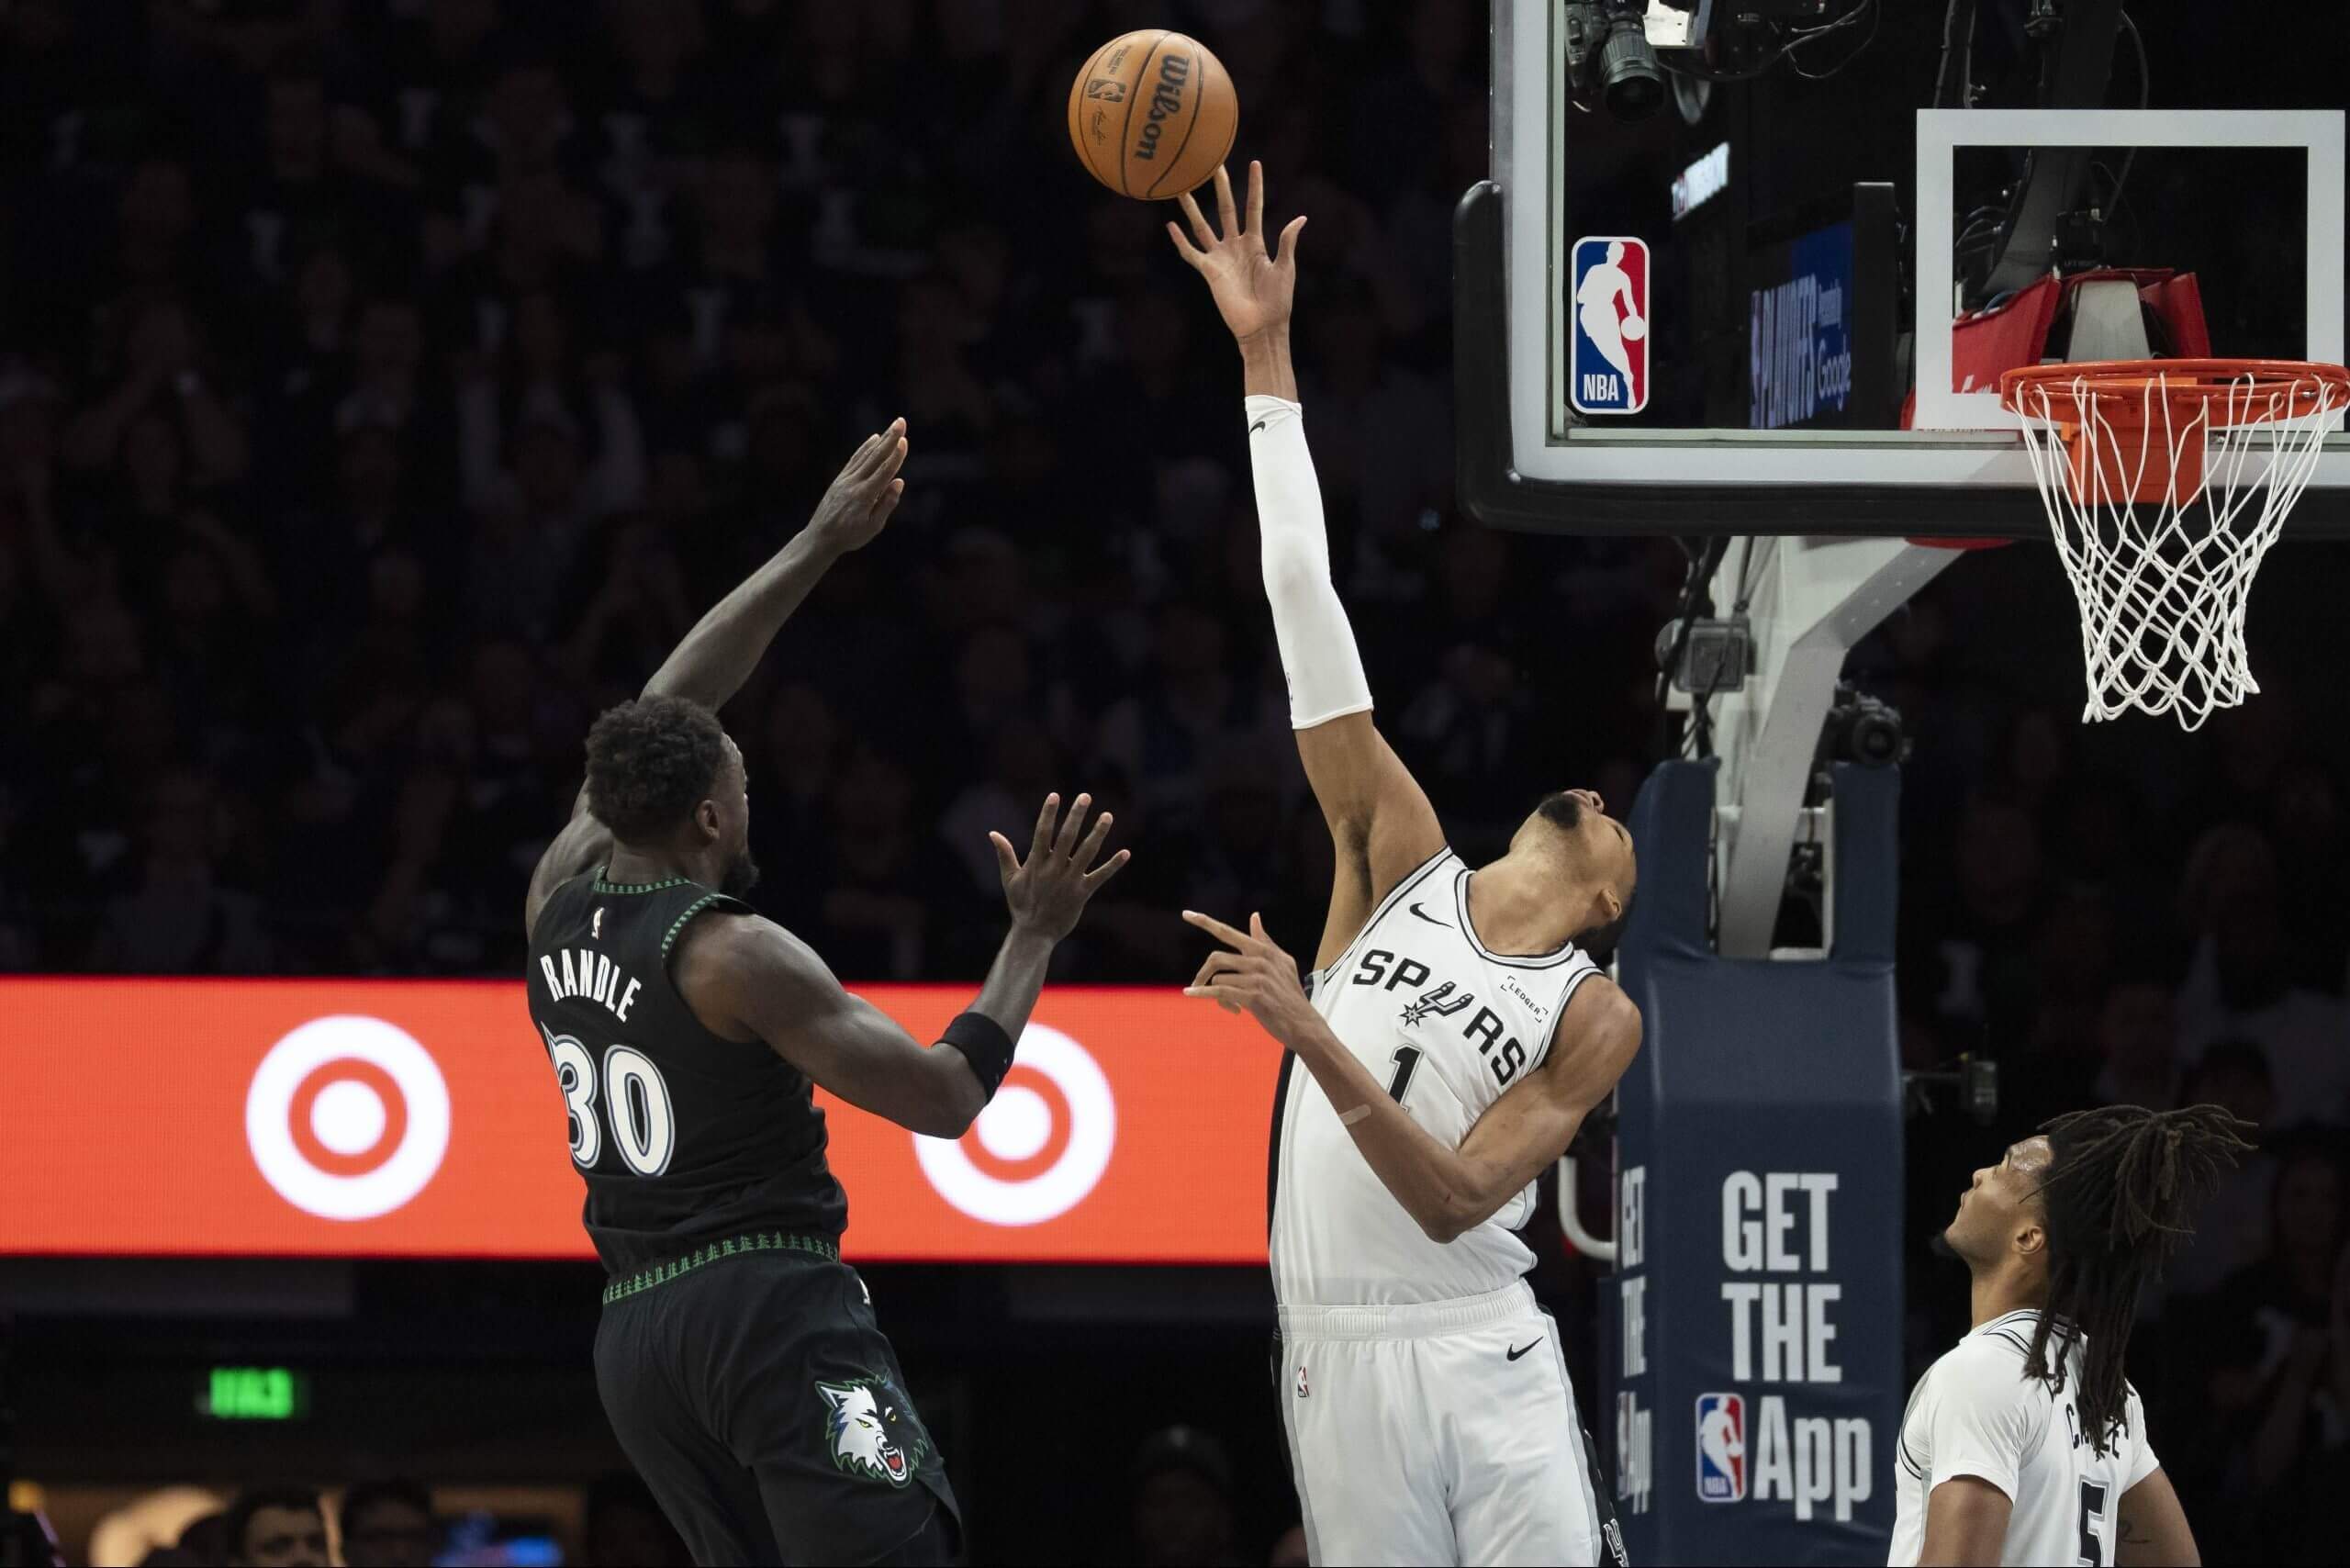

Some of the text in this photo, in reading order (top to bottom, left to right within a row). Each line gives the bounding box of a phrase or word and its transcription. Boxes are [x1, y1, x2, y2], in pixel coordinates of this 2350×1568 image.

[1134, 53, 1190, 161] Wilson
[1583, 374, 1619, 402] NBA
[540, 948, 642, 1023] RANDLE
[1352, 948, 1526, 1087] SPURS
[1508, 981, 1541, 1016] LEDGER
[541, 1020, 676, 1177] 30
[1387, 1042, 1424, 1114] 1
[1721, 1170, 1839, 1272] GET
[1721, 1282, 1841, 1383] THE
[1752, 1395, 1873, 1522] App
[2077, 1473, 2110, 1567] 5
